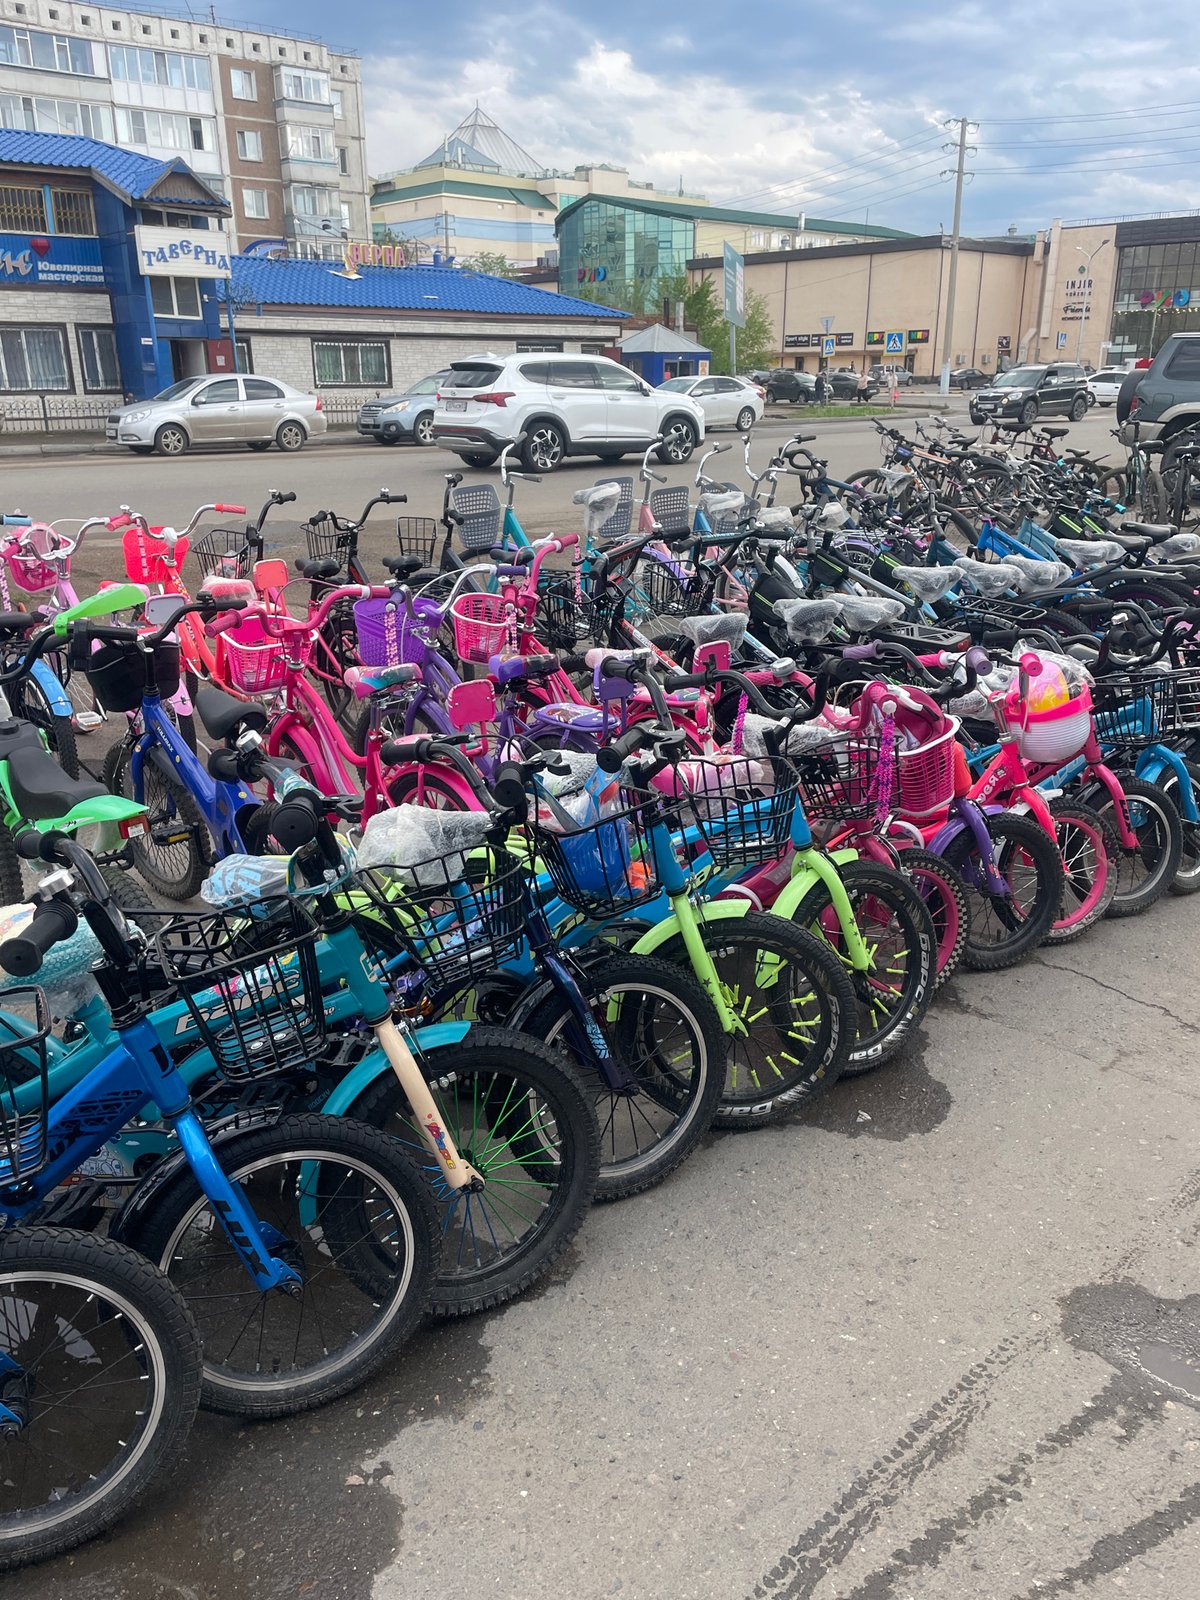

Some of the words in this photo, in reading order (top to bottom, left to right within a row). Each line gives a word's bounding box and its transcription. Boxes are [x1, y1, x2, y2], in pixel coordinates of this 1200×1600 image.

[38, 261, 104, 273] Ювелирная
[38, 272, 105, 283] мастерская
[1066, 280, 1092, 290] INJIR
[211, 1200, 272, 1277] LUX
